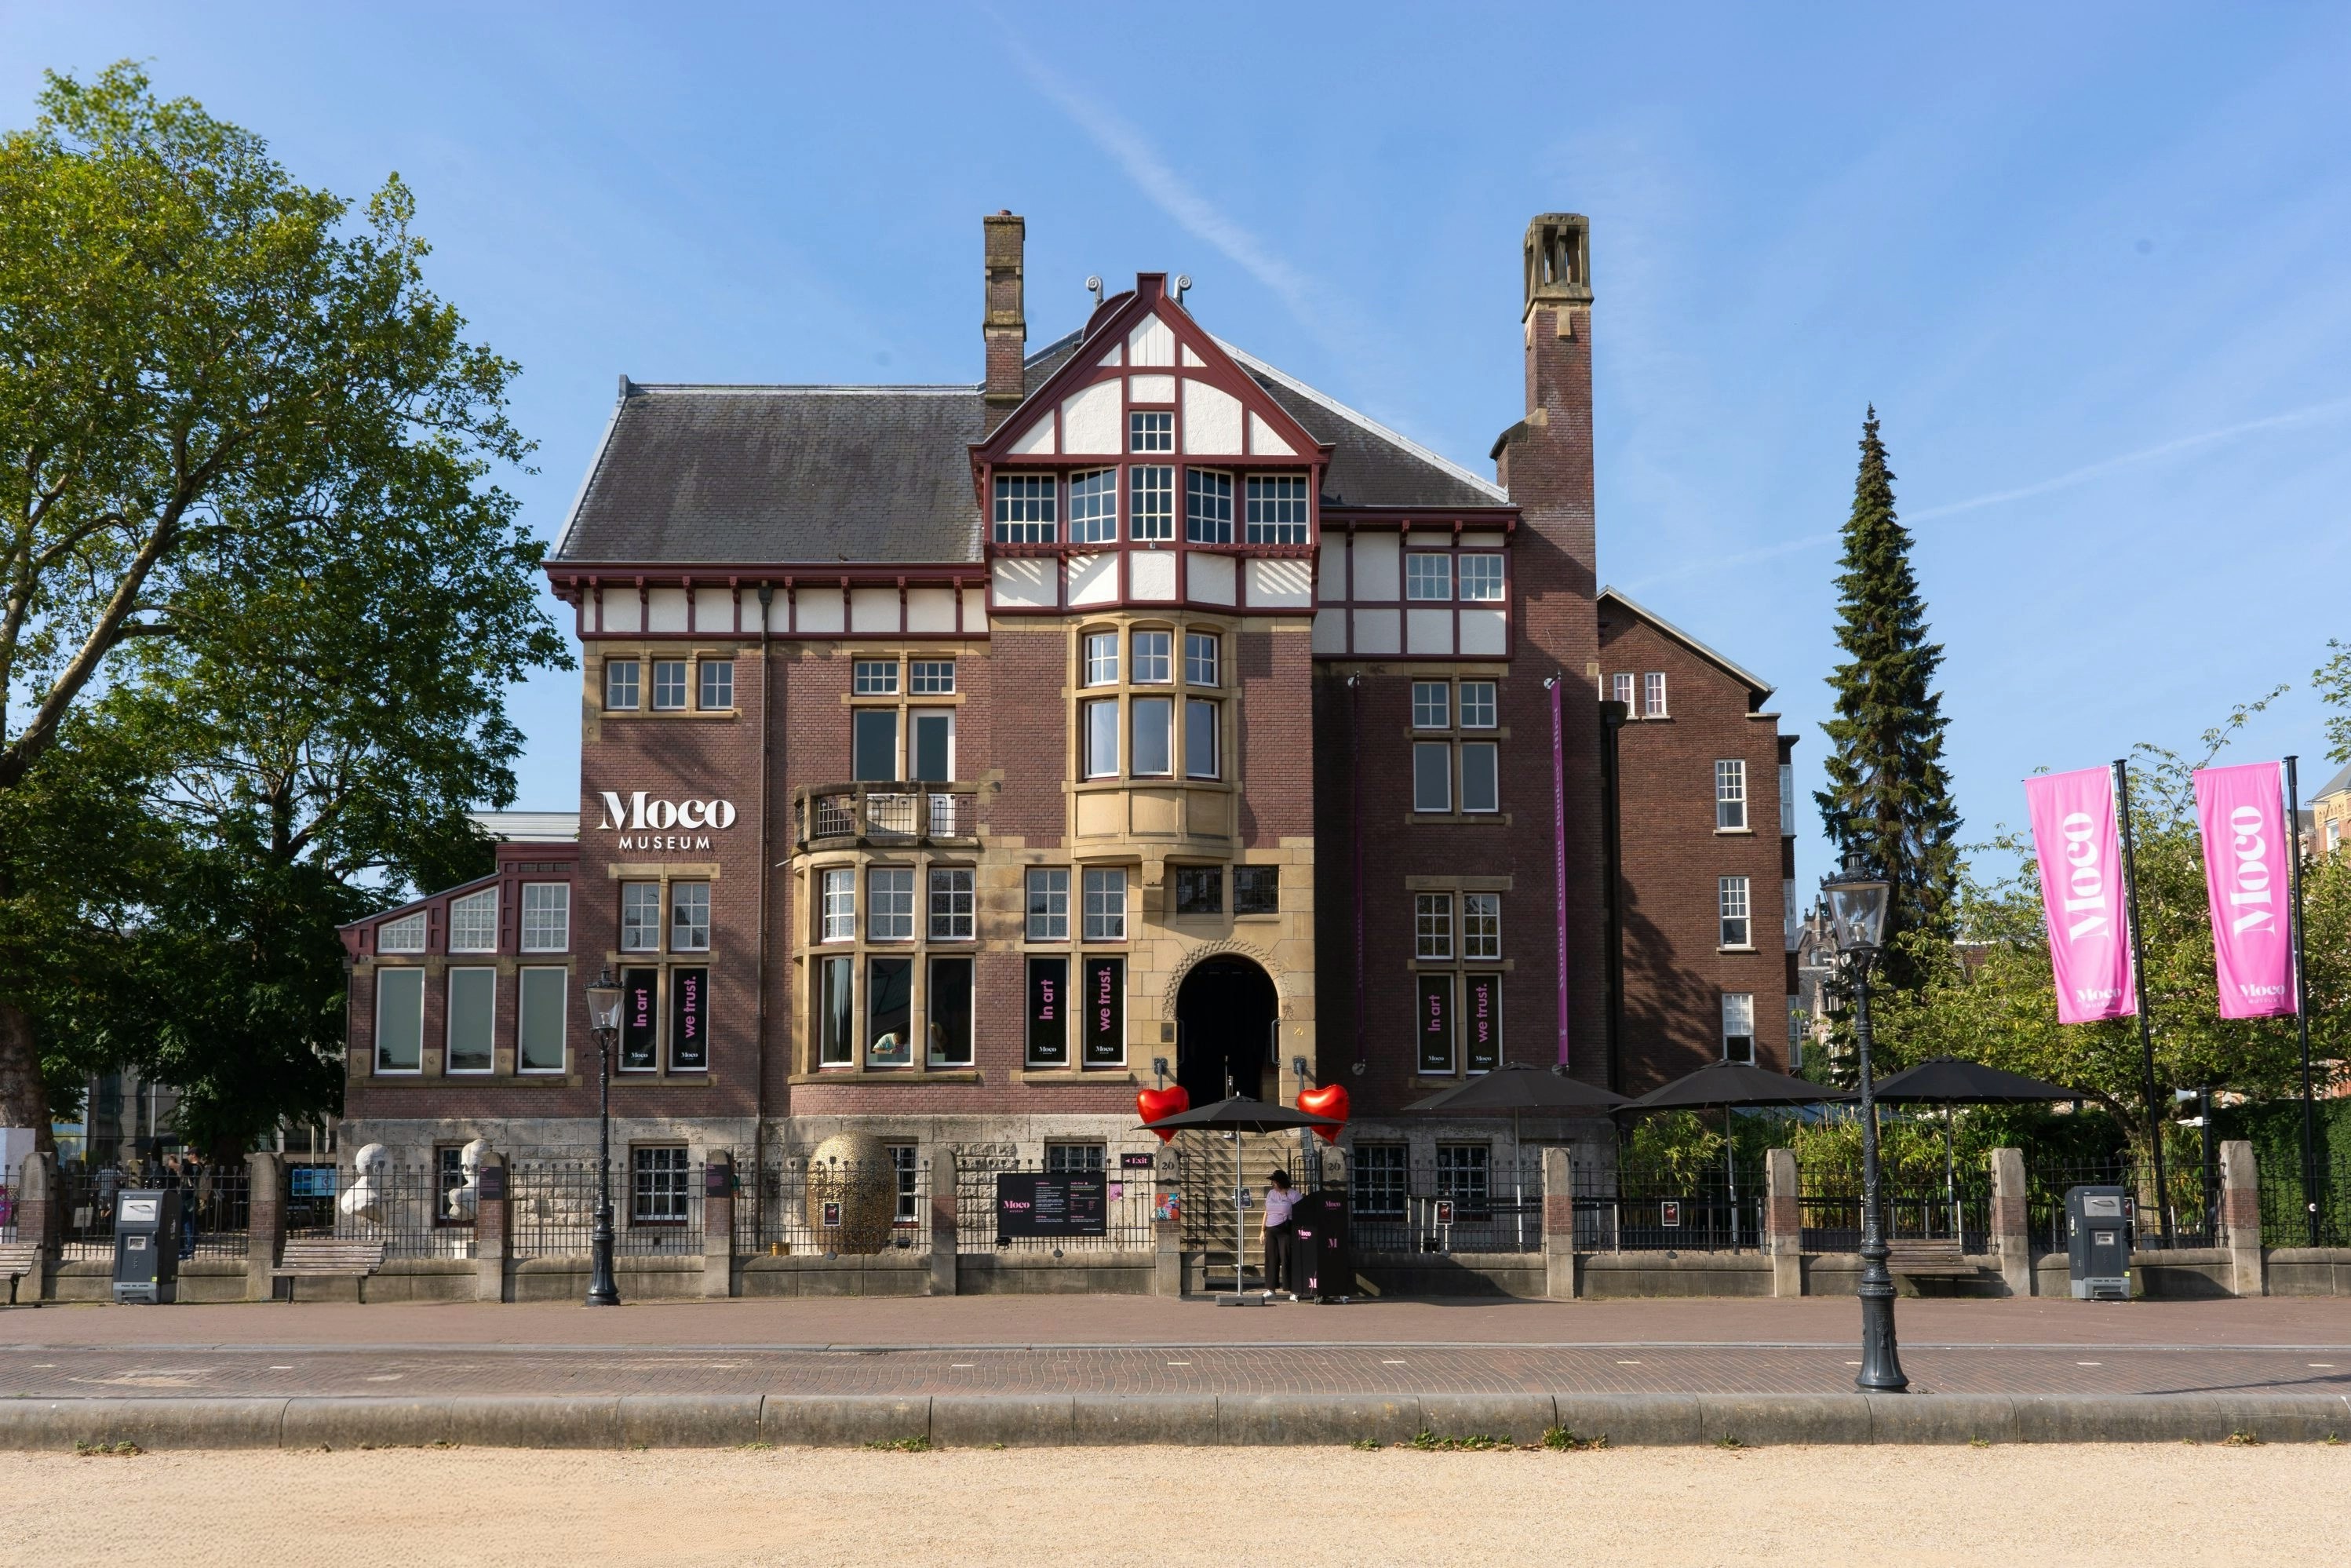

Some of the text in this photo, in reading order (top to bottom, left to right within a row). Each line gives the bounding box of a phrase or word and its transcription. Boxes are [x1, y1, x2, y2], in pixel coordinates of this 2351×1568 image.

[596, 791, 736, 831] Moco
[618, 836, 710, 849] MUSEUM
[2063, 811, 2110, 946] Moco
[2230, 805, 2276, 940] Moco
[633, 989, 647, 1026] In art
[683, 975, 697, 1038] we trust.
[1038, 979, 1054, 1019] In art
[1098, 966, 1111, 1031] we trust.
[2076, 988, 2122, 1003] Moco
[2239, 983, 2285, 997] Moco
[1427, 994, 1441, 1031] In art
[1476, 983, 1488, 1043] we trust.
[1004, 1200, 1030, 1209] Moco
